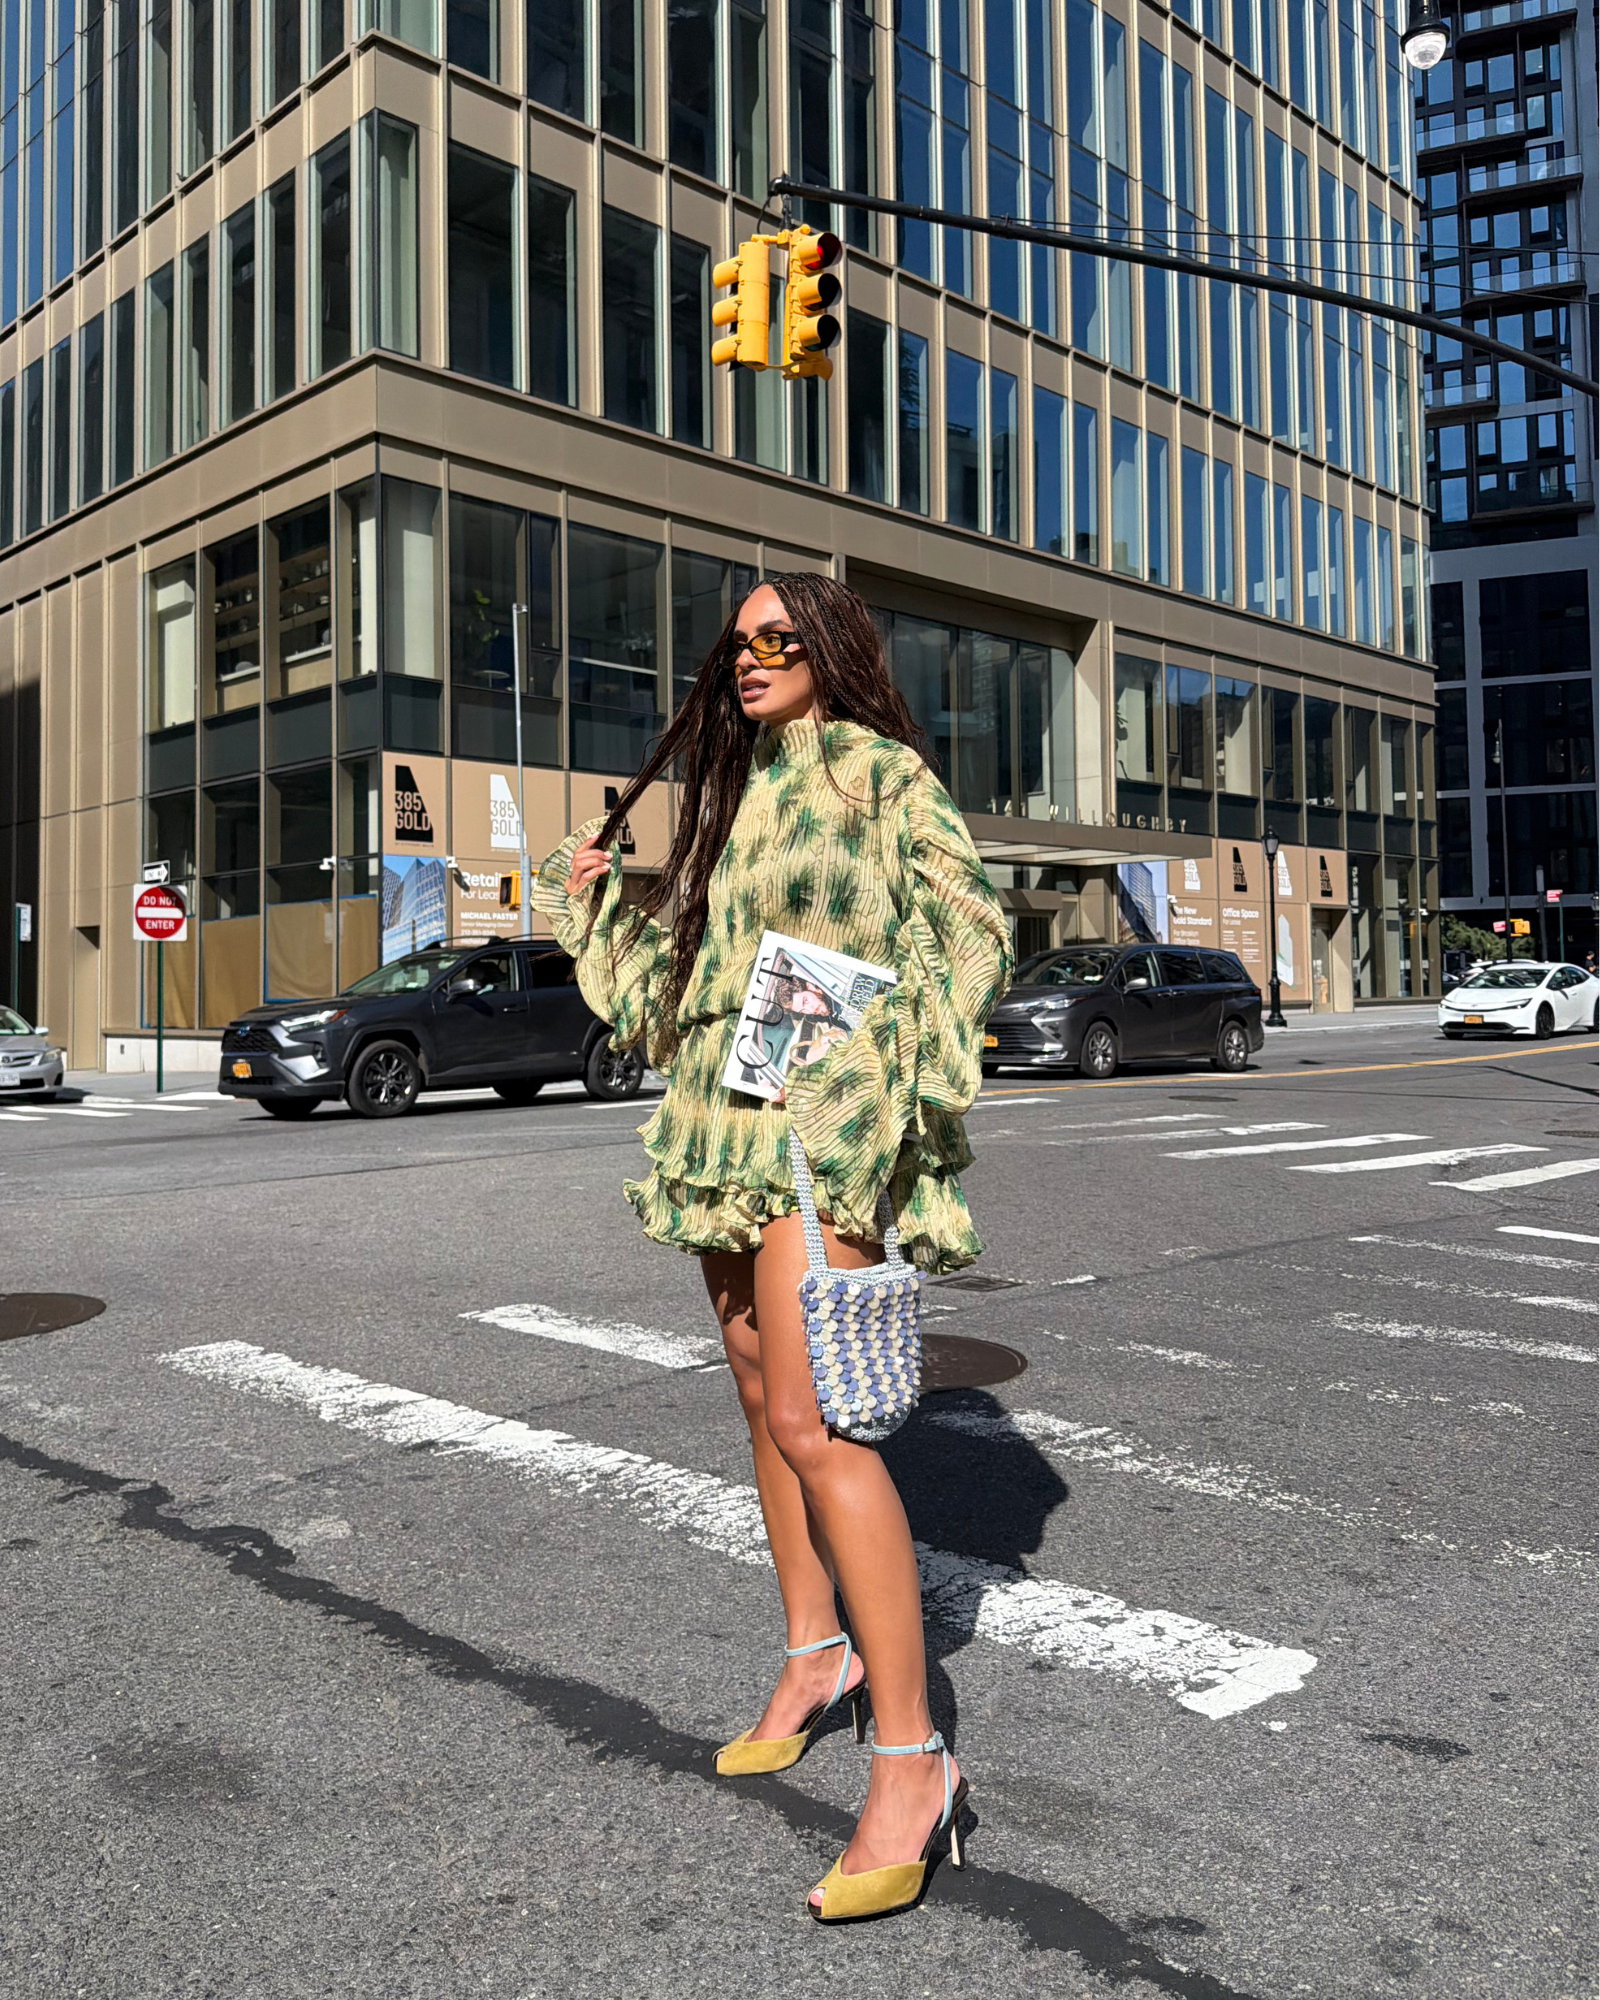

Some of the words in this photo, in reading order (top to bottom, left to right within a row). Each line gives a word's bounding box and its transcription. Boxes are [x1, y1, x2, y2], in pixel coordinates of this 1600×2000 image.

[395, 791, 422, 811] 385
[490, 800, 515, 818] 385
[395, 811, 431, 831] GOLD
[1049, 804, 1187, 833] WILLOUGHBY
[143, 896, 156, 905] DO
[158, 896, 177, 906] NOT
[461, 890, 476, 900] For
[478, 889, 500, 900] Leas
[460, 911, 491, 920] MICHAEL
[492, 912, 518, 921] PASTER
[1222, 907, 1241, 918] Office
[1241, 908, 1259, 919] Space
[145, 920, 175, 930] ENTER
[736, 957, 793, 1069] CUT
